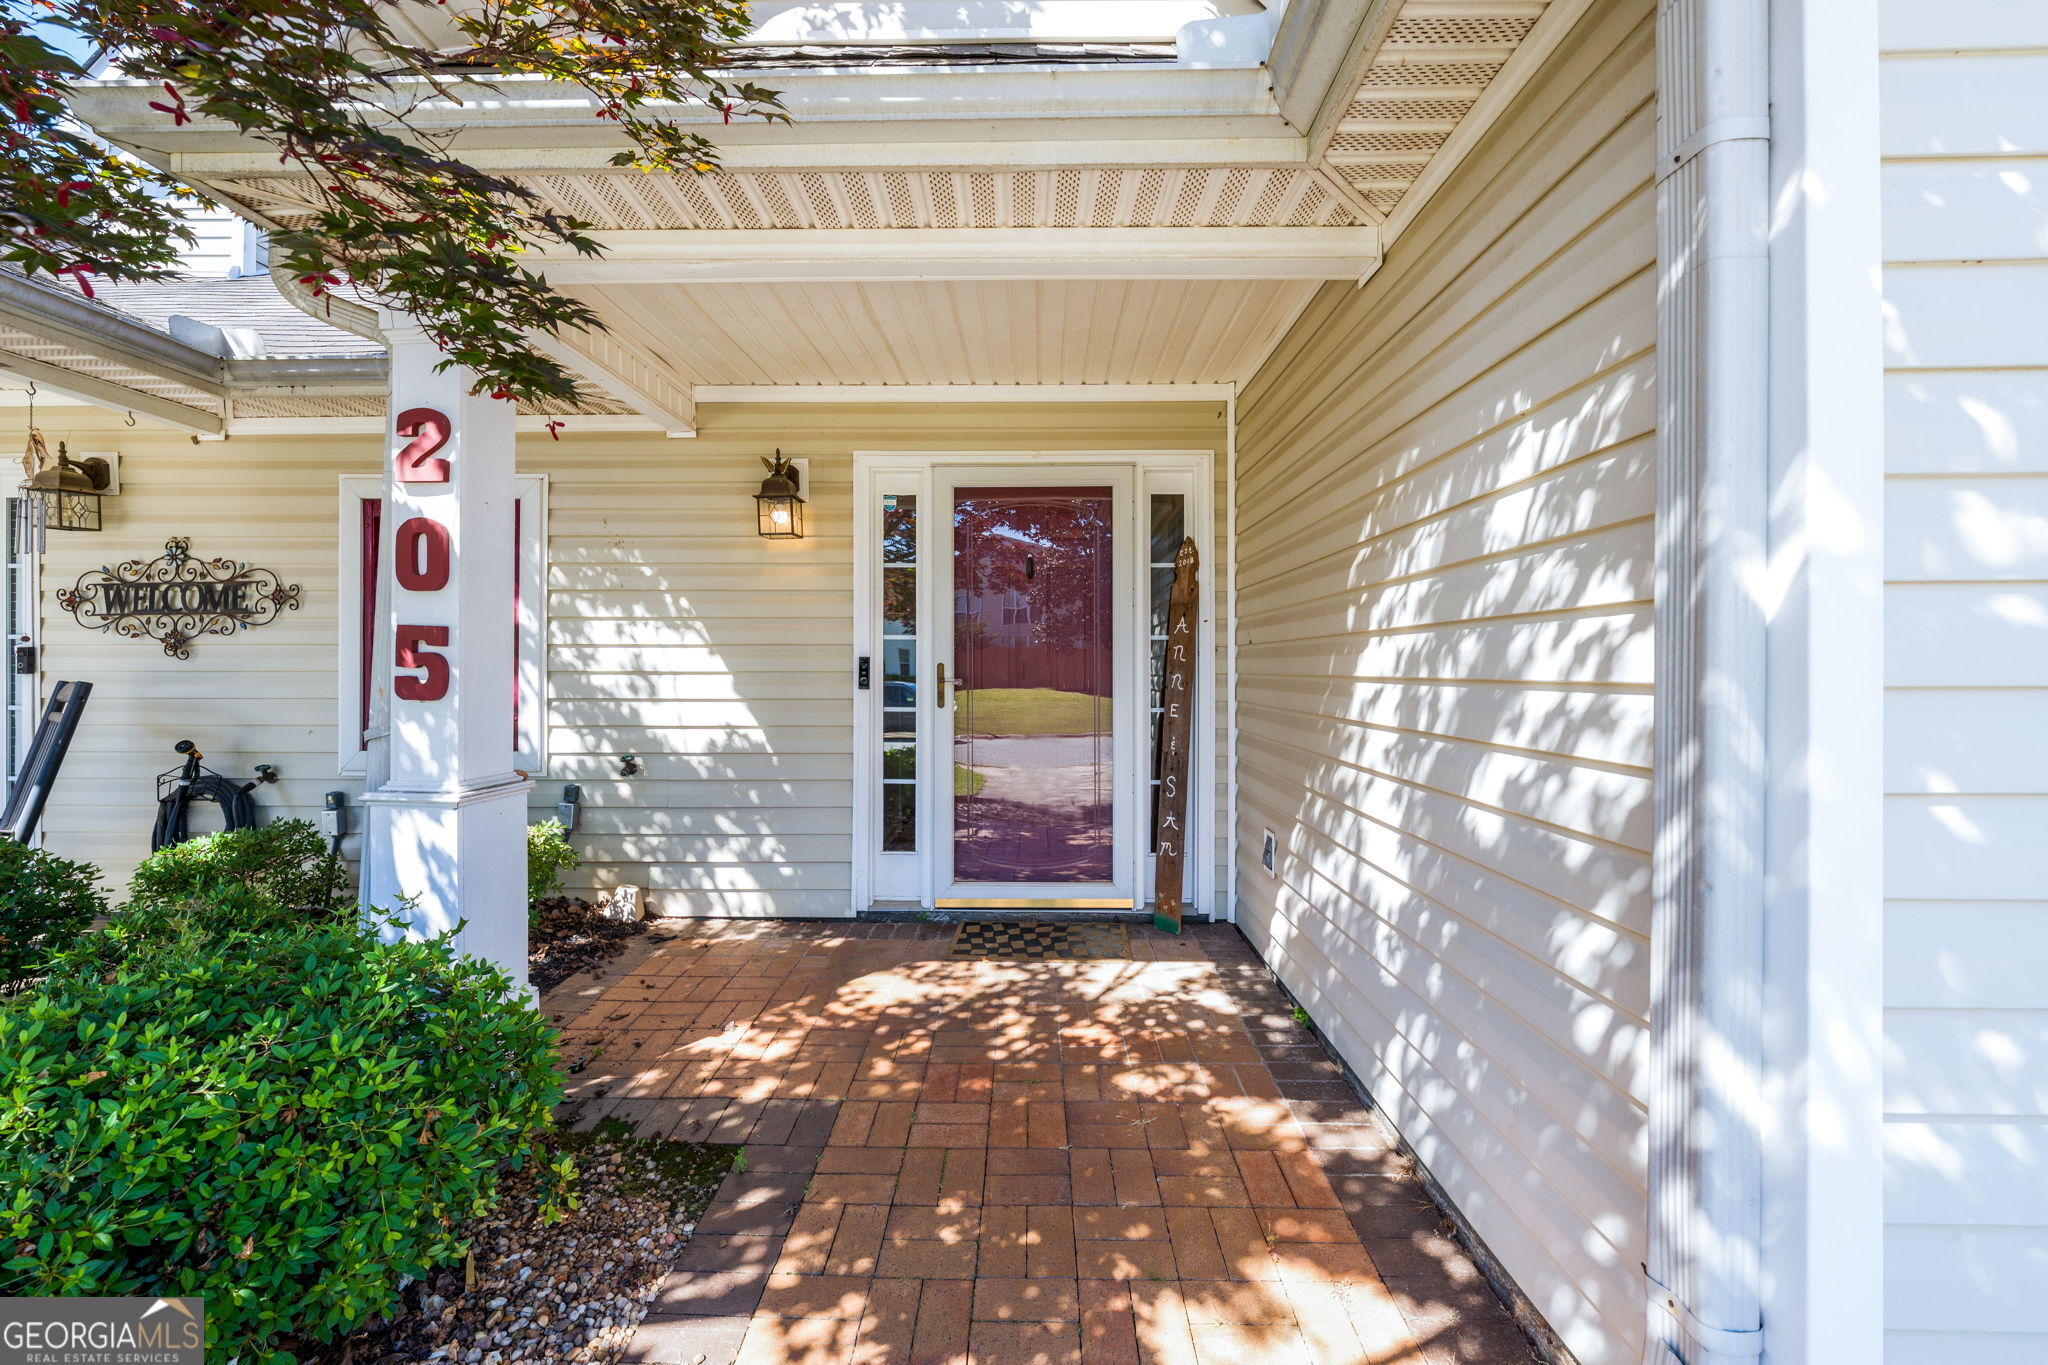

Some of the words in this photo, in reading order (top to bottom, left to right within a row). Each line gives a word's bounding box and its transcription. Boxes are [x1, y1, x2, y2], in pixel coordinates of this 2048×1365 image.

[394, 407, 451, 701] 205
[1178, 557, 1194, 567] 2018
[101, 583, 249, 615] WELCOME
